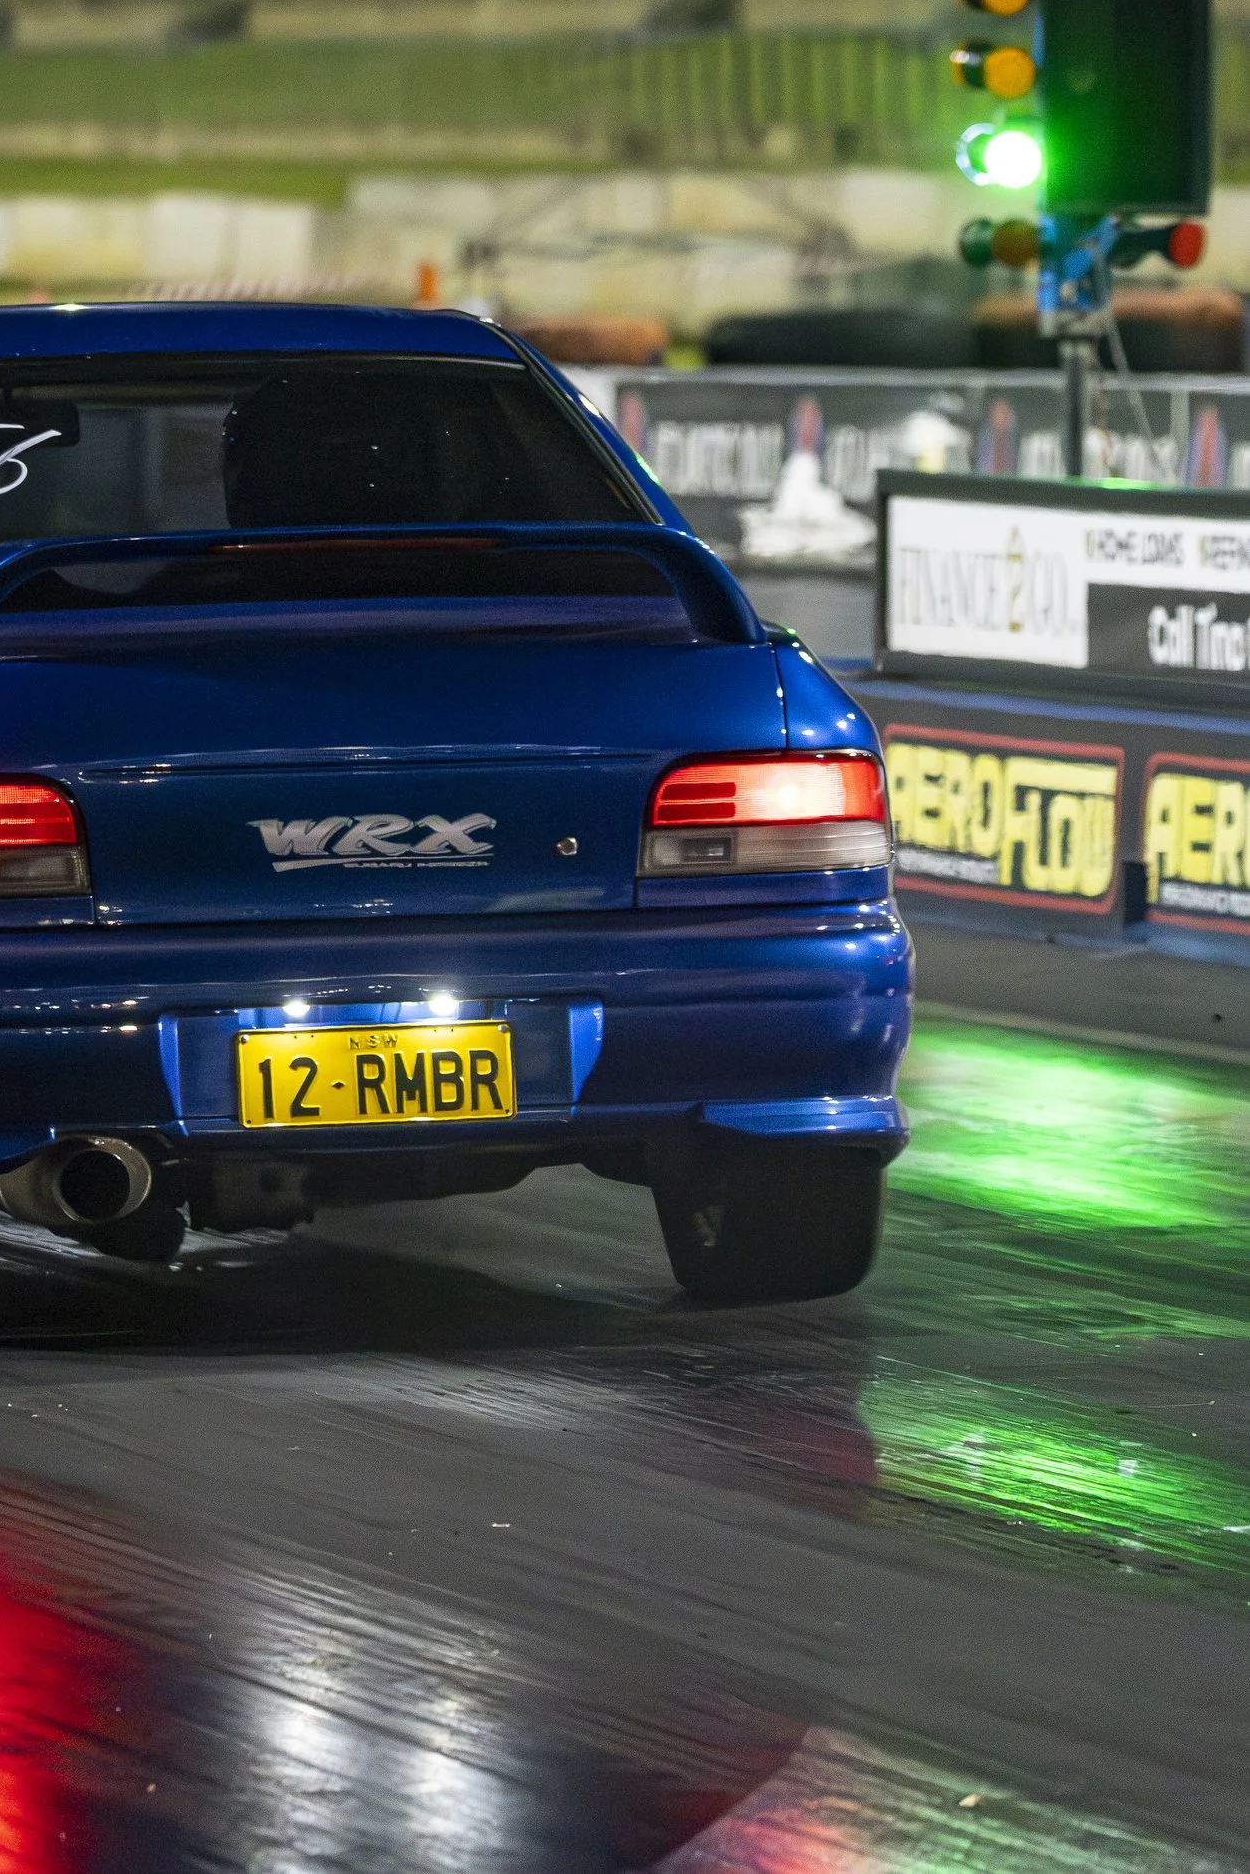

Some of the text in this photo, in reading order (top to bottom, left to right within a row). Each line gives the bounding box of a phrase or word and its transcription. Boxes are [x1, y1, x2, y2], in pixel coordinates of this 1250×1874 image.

[1148, 605, 1194, 668] Call
[247, 813, 497, 856] WRX
[886, 742, 1118, 897] AEROFLOW
[1144, 772, 1250, 906] AER
[349, 1034, 399, 1051] NSW
